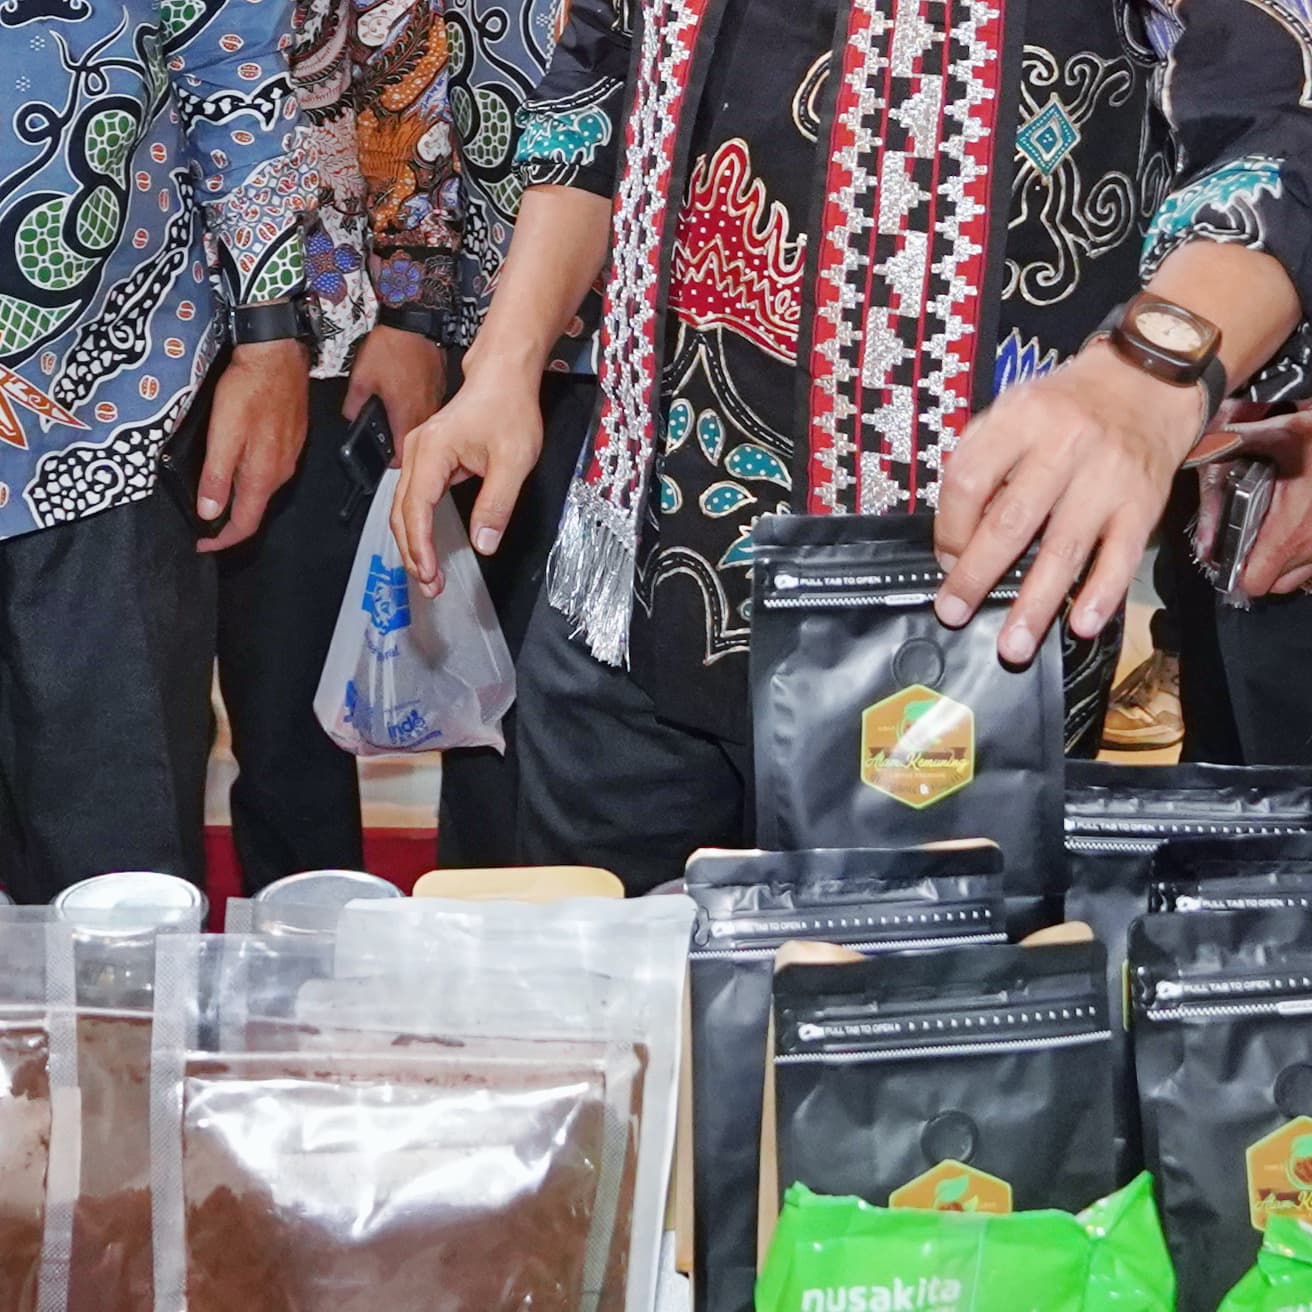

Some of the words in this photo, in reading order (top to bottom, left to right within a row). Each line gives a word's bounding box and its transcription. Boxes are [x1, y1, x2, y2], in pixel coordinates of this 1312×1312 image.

[799, 577, 823, 587] PULL
[824, 576, 843, 587] TAB
[843, 576, 856, 586] TO
[855, 575, 882, 585] OPEN
[1209, 983, 1229, 992] TAB
[1229, 982, 1243, 992] TO
[1243, 980, 1271, 990] OPEN
[844, 1026, 860, 1036] TAB
[860, 1025, 872, 1036] TO
[800, 1276, 961, 1312] nusakita
